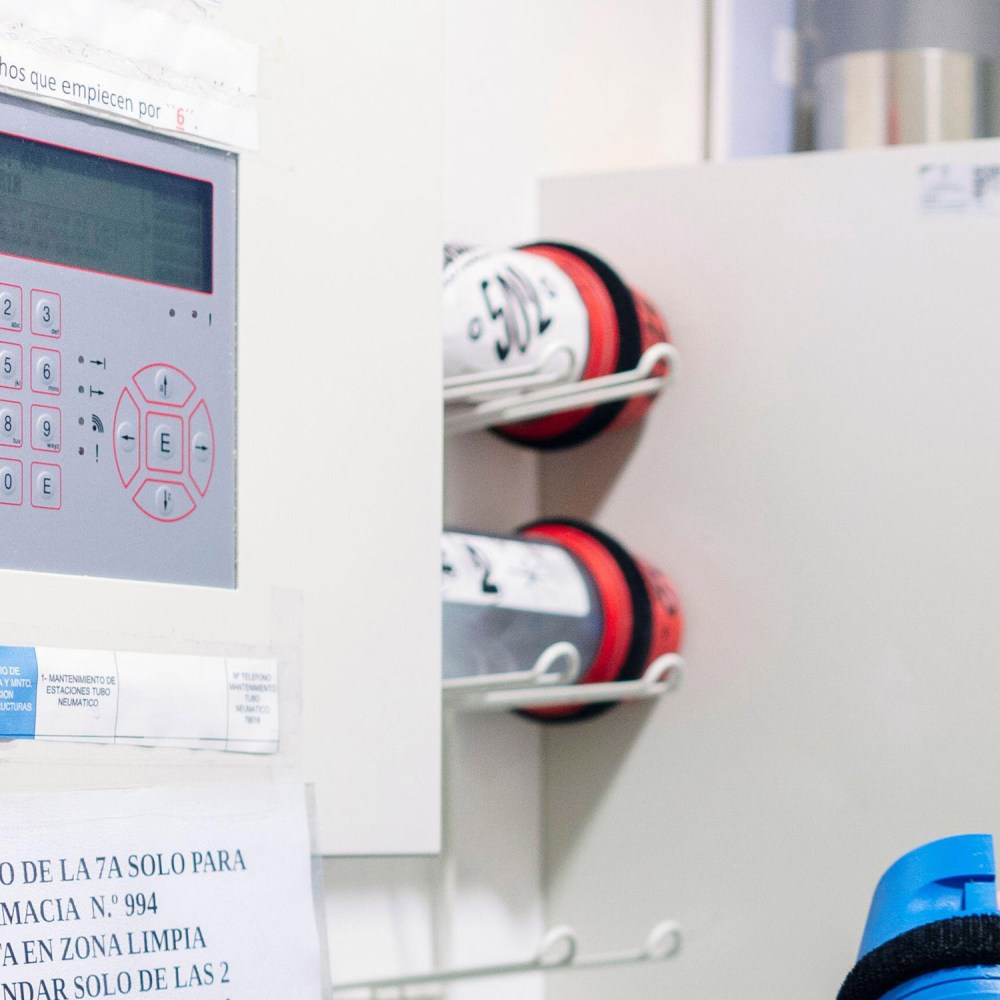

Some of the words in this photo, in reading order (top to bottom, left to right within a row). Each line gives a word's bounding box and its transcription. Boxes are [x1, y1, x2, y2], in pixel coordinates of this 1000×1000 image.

[30, 70, 57, 90] que
[61, 80, 134, 112] empiecen
[138, 101, 162, 119] por
[3, 298, 12, 316] 2
[42, 305, 51, 322] 3
[4, 356, 12, 373] 5
[43, 363, 51, 380] 6
[4, 415, 12, 432] 8
[43, 420, 51, 437] 9
[160, 432, 171, 453] E
[43, 477, 51, 494] E
[9, 667, 20, 676] DE
[48, 674, 105, 684] MANTENIMIENTO
[106, 676, 116, 685] DE
[4, 679, 10, 687] Y
[46, 686, 90, 695] ESTACIONES
[92, 687, 111, 696] TUBO
[0, 690, 14, 699] ION
[57, 698, 99, 707] NEUMATICO
[0, 702, 32, 712] UCTURAS
[0, 861, 15, 886] O
[22, 859, 53, 885] DE
[59, 857, 91, 882] LA
[95, 855, 123, 879] 7A
[128, 851, 186, 878] SOLO
[191, 849, 247, 874] PARA
[0, 897, 81, 927] MACIA
[125, 891, 158, 917] 994
[0, 941, 19, 967] A
[22, 938, 54, 965] EN
[60, 933, 123, 961] ZONA
[127, 926, 207, 955] LIMPIA
[73, 971, 132, 999] SOLO
[138, 967, 168, 993] DE
[174, 963, 215, 989] LAS
[219, 961, 231, 984] 2
